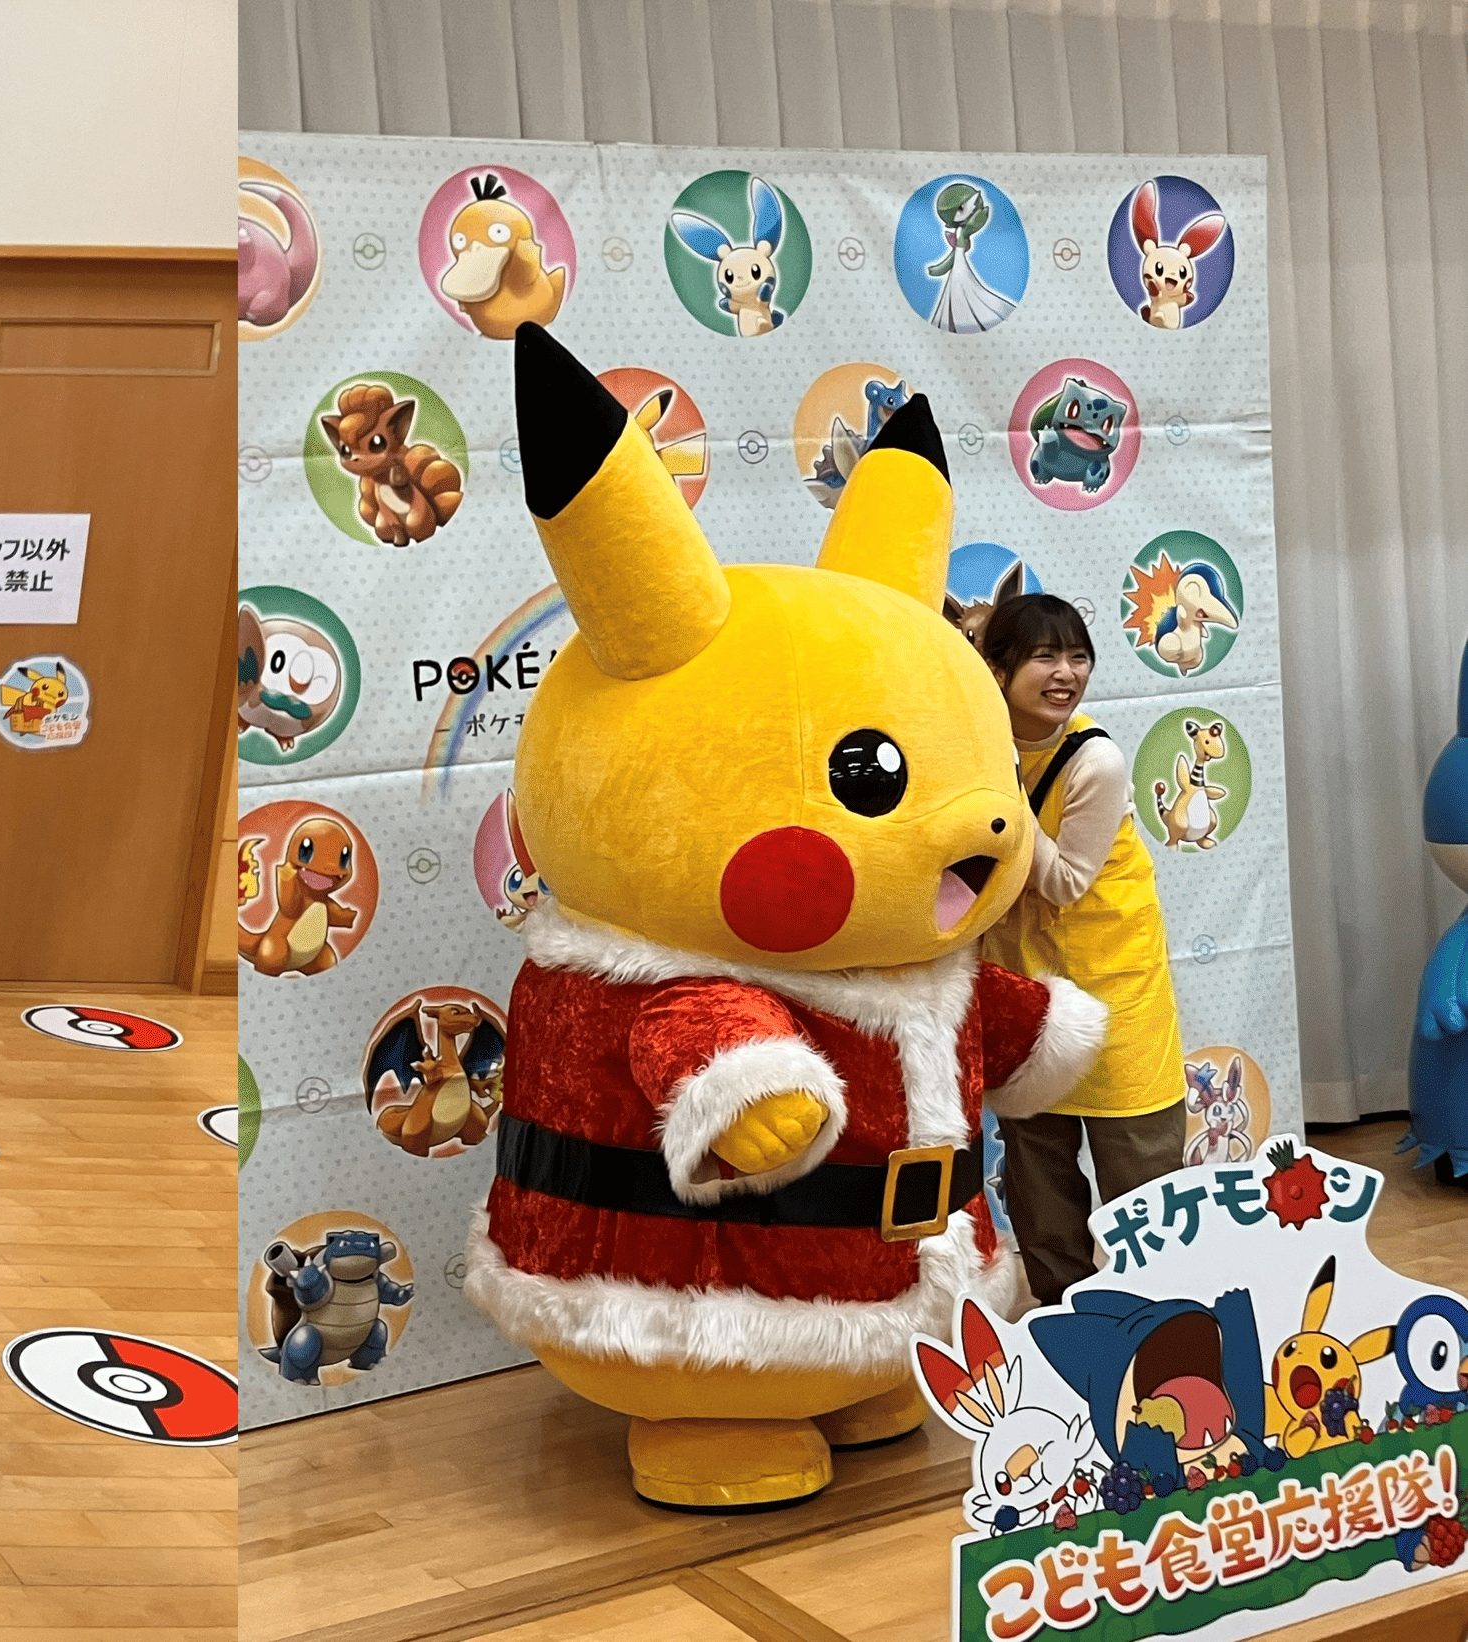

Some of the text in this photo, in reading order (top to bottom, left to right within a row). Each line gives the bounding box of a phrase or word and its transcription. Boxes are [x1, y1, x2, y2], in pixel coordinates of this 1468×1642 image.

[413, 641, 557, 702] POKÉ
[1103, 1167, 1377, 1273] ポケモン
[983, 1451, 1455, 1640] こども食堂応援隊!
